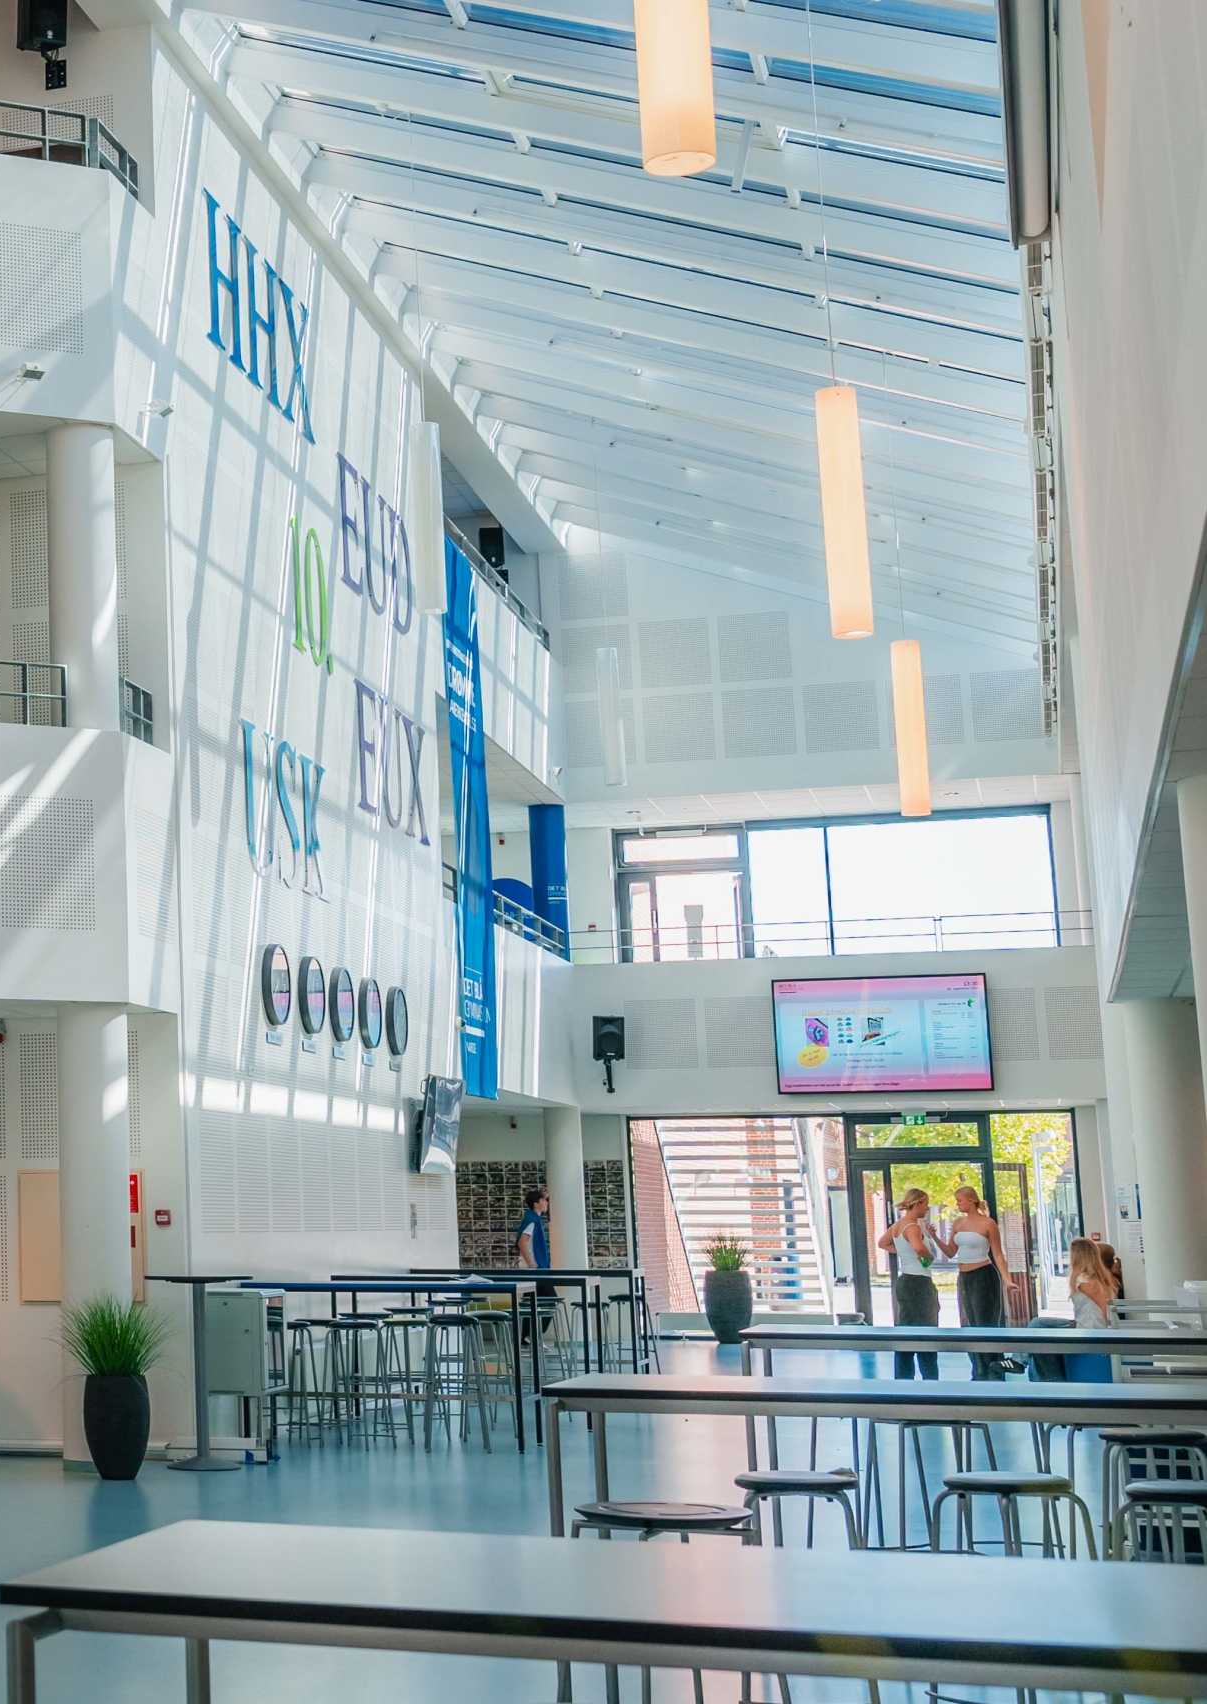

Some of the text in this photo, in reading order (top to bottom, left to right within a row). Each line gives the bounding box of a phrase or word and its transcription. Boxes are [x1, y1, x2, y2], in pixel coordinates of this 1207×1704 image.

[203, 187, 316, 445] HHX
[336, 450, 412, 635] EUD
[240, 717, 331, 903] USK
[354, 678, 431, 846] EUX
